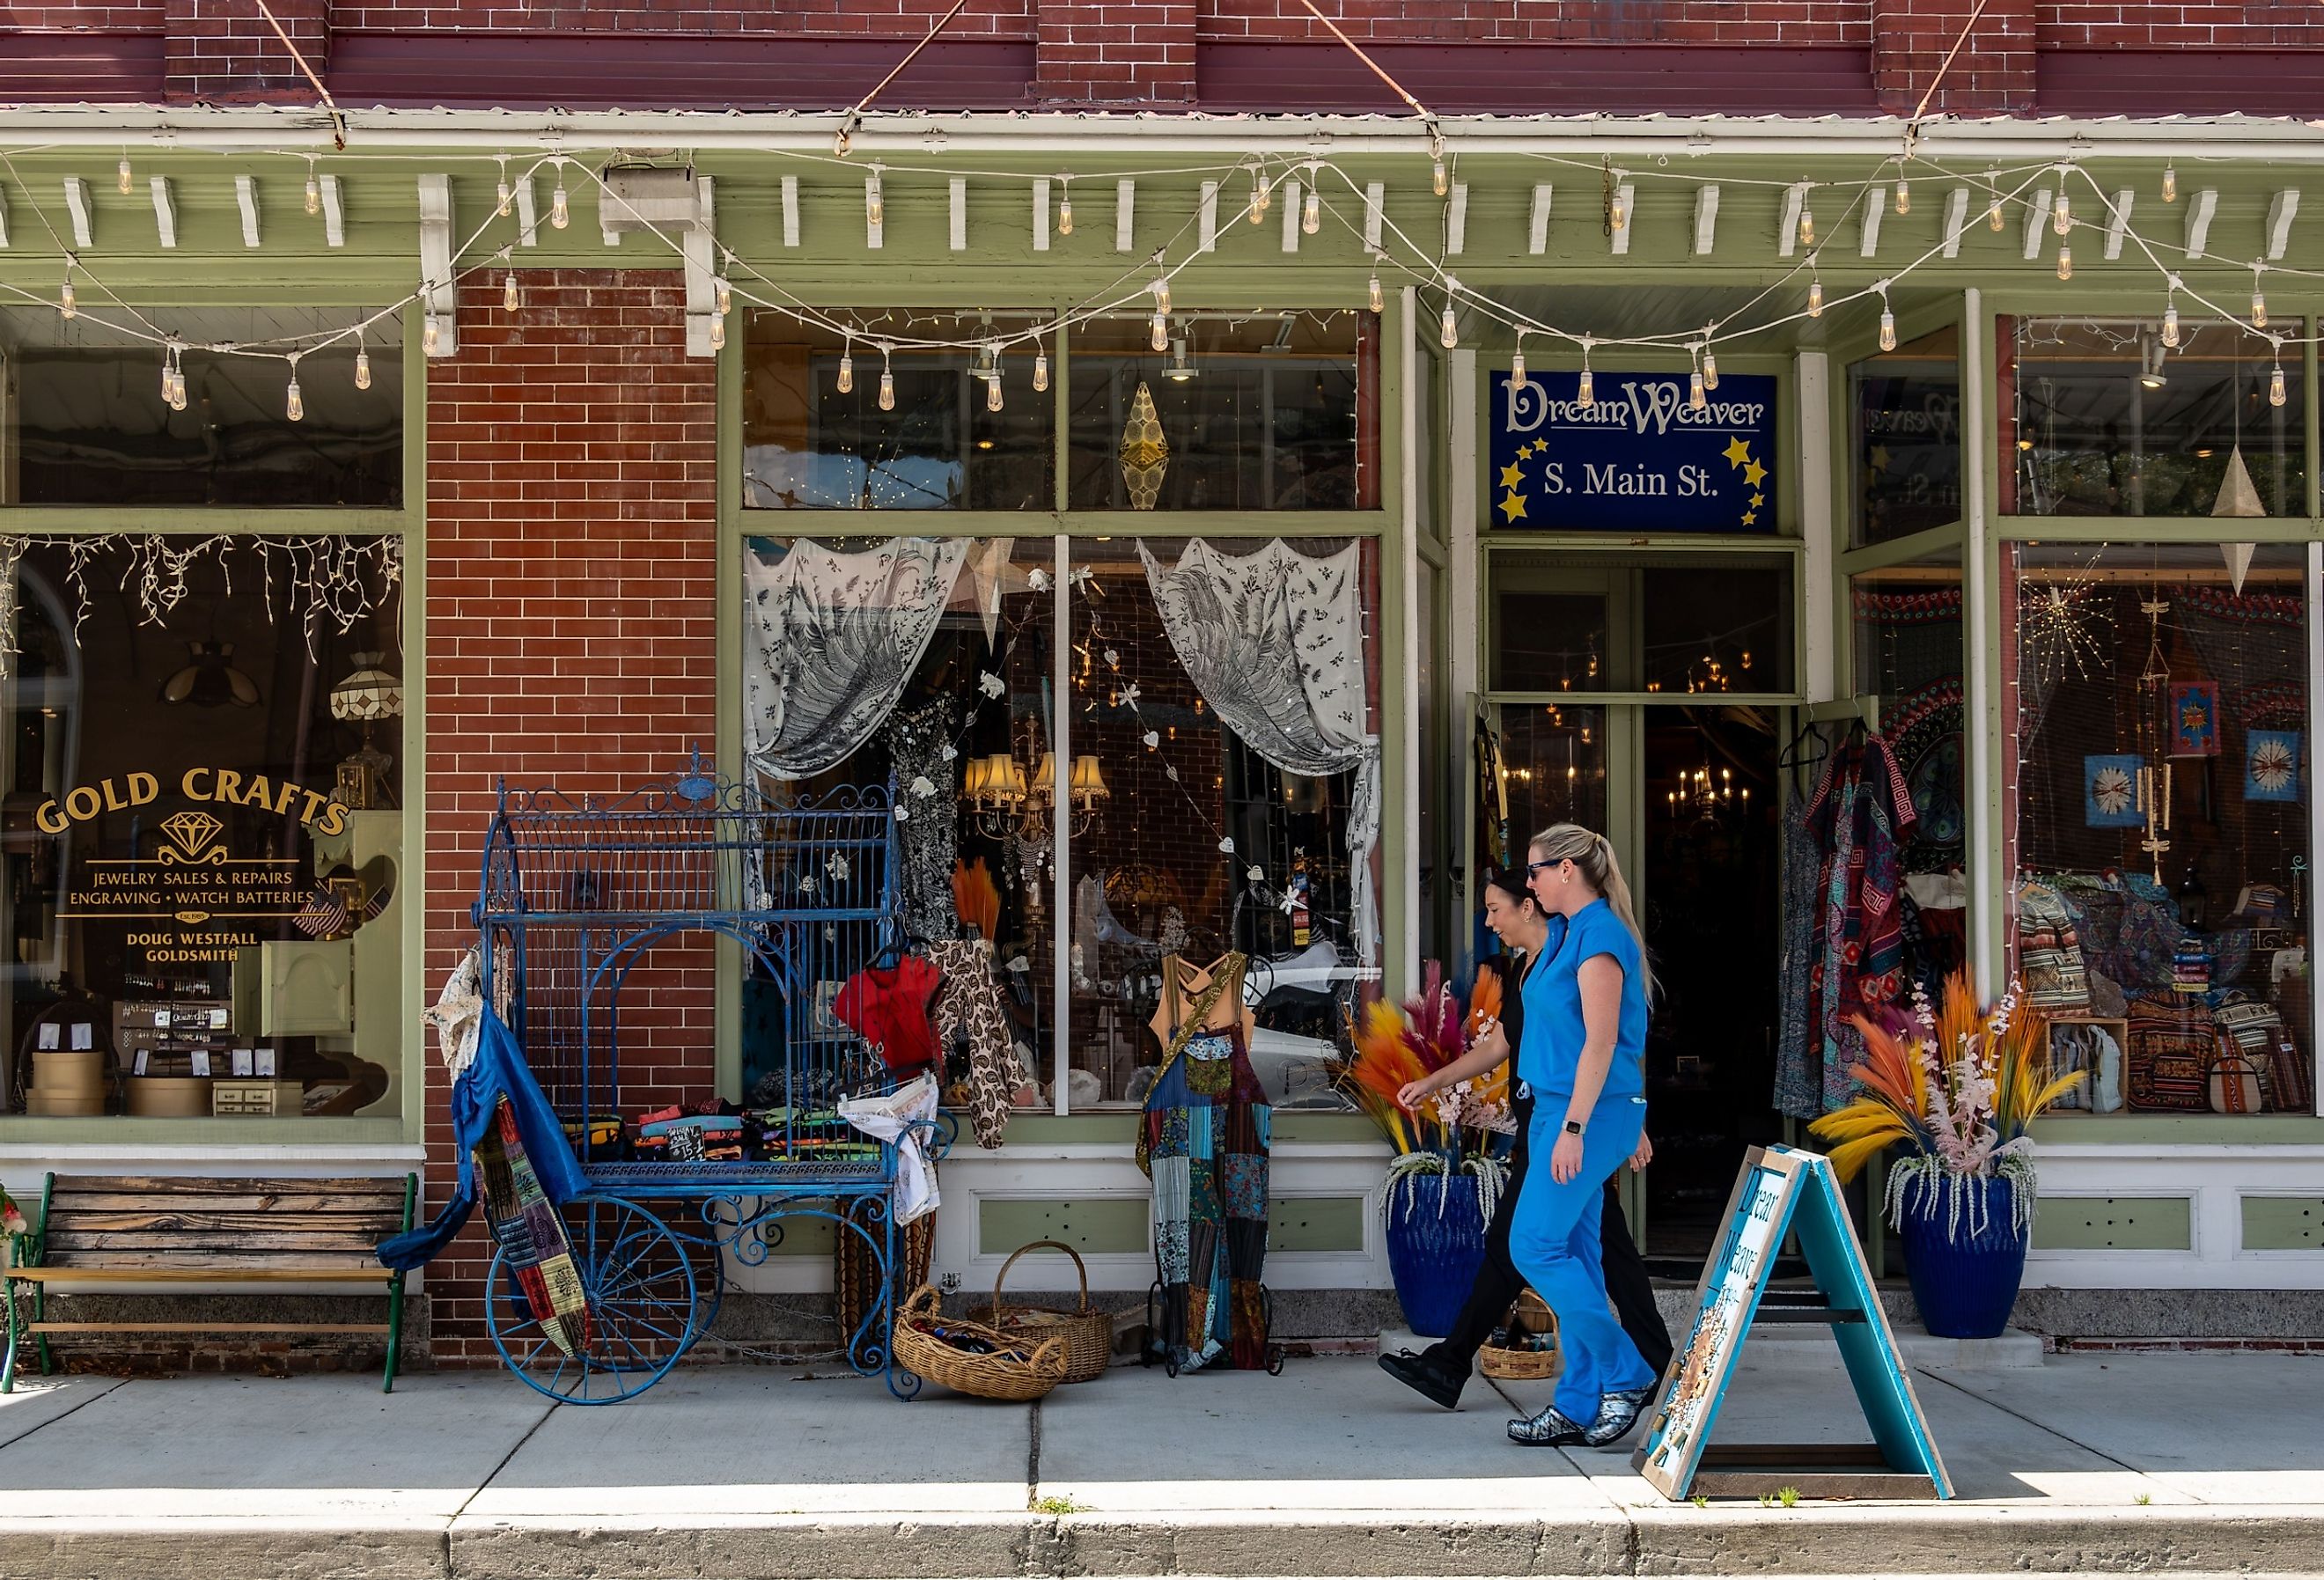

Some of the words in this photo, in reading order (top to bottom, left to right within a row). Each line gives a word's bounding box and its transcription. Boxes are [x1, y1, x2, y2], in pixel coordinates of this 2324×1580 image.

[1544, 462, 1572, 494] S.
[1582, 463, 1668, 496] Main
[1678, 465, 1718, 496] St.
[36, 771, 159, 834] GOLD
[181, 767, 350, 836] CRAFTS
[93, 872, 157, 888] JEWELRY
[163, 872, 209, 885] SALES
[215, 872, 227, 885] &
[232, 871, 292, 885] REPAIRS
[70, 892, 161, 905] ENGRAVING
[175, 892, 229, 904] WATCH
[236, 891, 314, 904] BATTERIES
[127, 933, 173, 945] DOUG
[180, 933, 258, 945] WESTFALL
[145, 949, 239, 962] GOLDSMITH
[1719, 1229, 1759, 1281] Weave
